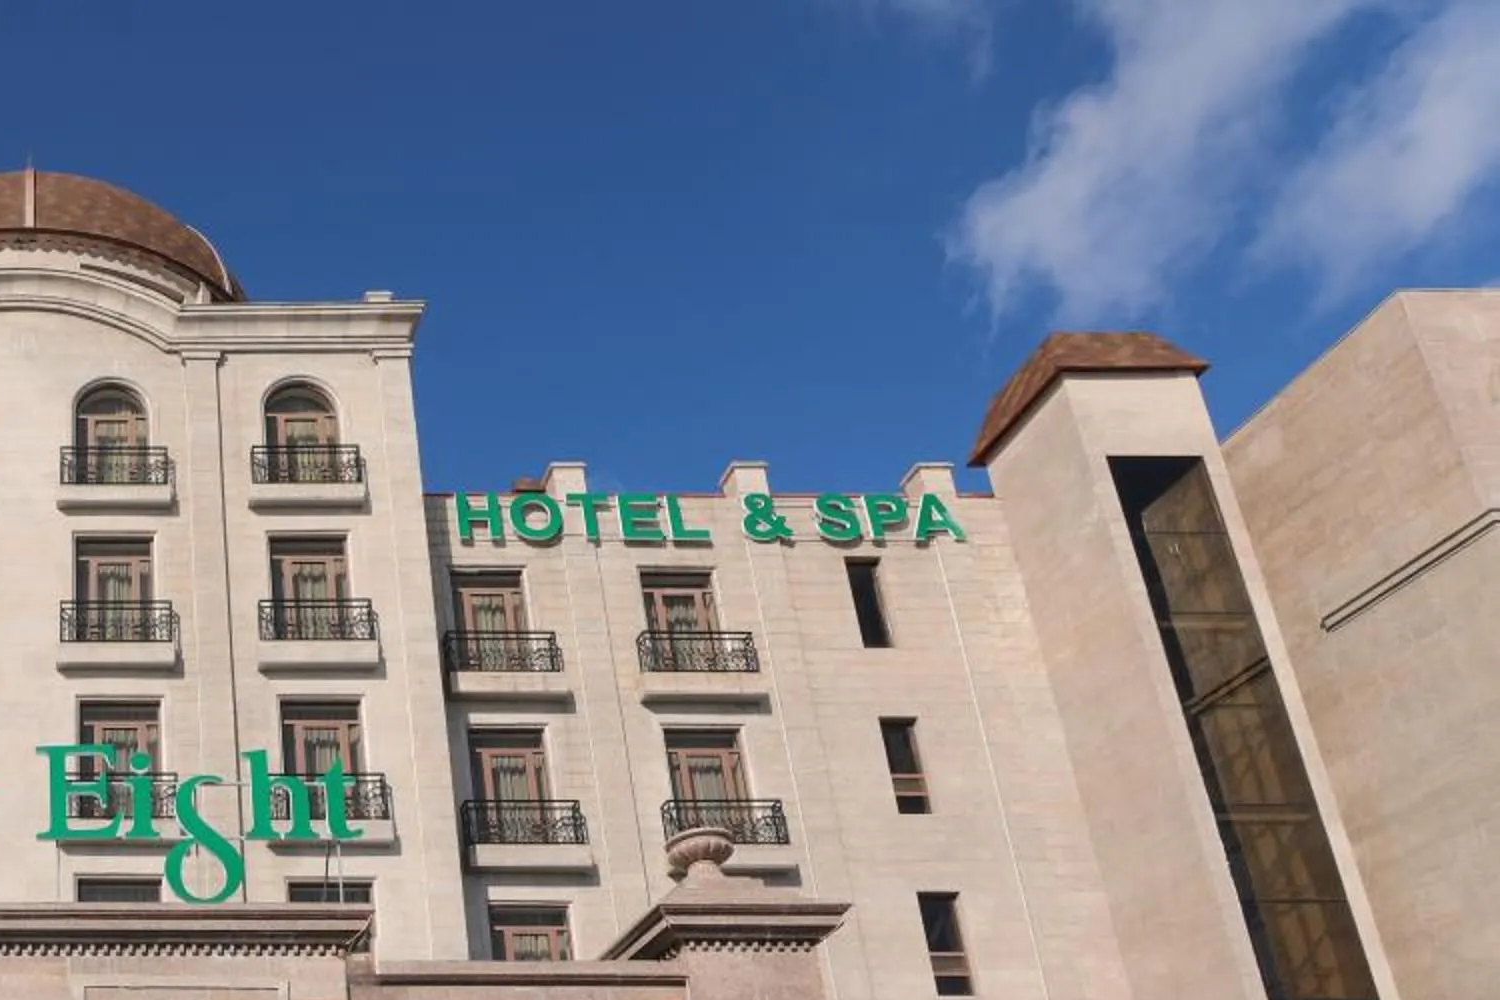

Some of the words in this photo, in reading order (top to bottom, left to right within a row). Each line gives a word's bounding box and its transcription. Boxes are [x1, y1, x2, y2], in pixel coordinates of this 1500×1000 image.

[454, 489, 711, 542] HOTEL
[742, 491, 794, 542] &
[814, 491, 966, 542] SPA
[35, 743, 364, 905] Eight
